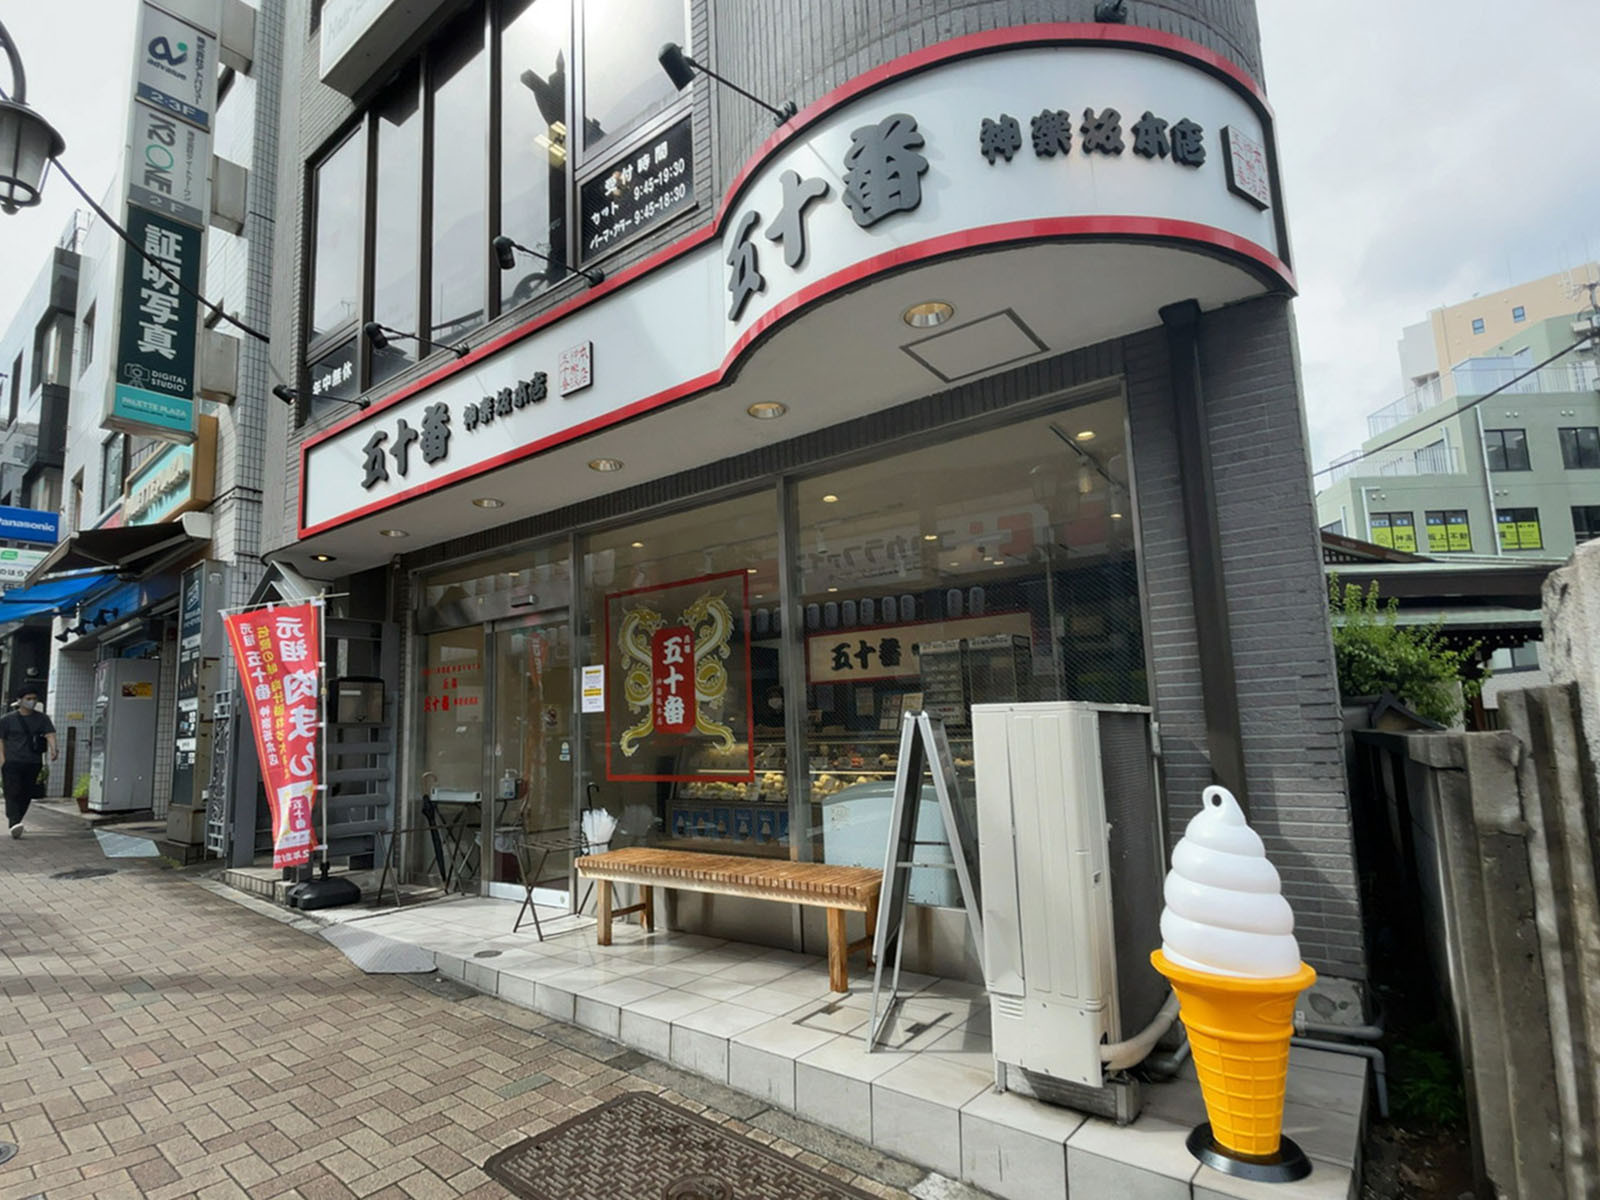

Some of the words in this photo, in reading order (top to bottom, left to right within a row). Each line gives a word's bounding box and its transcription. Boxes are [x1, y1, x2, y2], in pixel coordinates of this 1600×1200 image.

[604, 141, 668, 196] 受付時間
[591, 201, 619, 225] カット
[728, 112, 930, 323] 五十番
[979, 107, 1207, 168] 神楽坂本店
[137, 224, 183, 360] 証明写真
[151, 370, 187, 385] DIGITAL
[151, 378, 184, 392] STUDIO
[312, 360, 353, 395] 年中無休
[361, 401, 451, 491] 五十番
[831, 637, 902, 672] 五十番
[662, 636, 685, 725] 五十番
